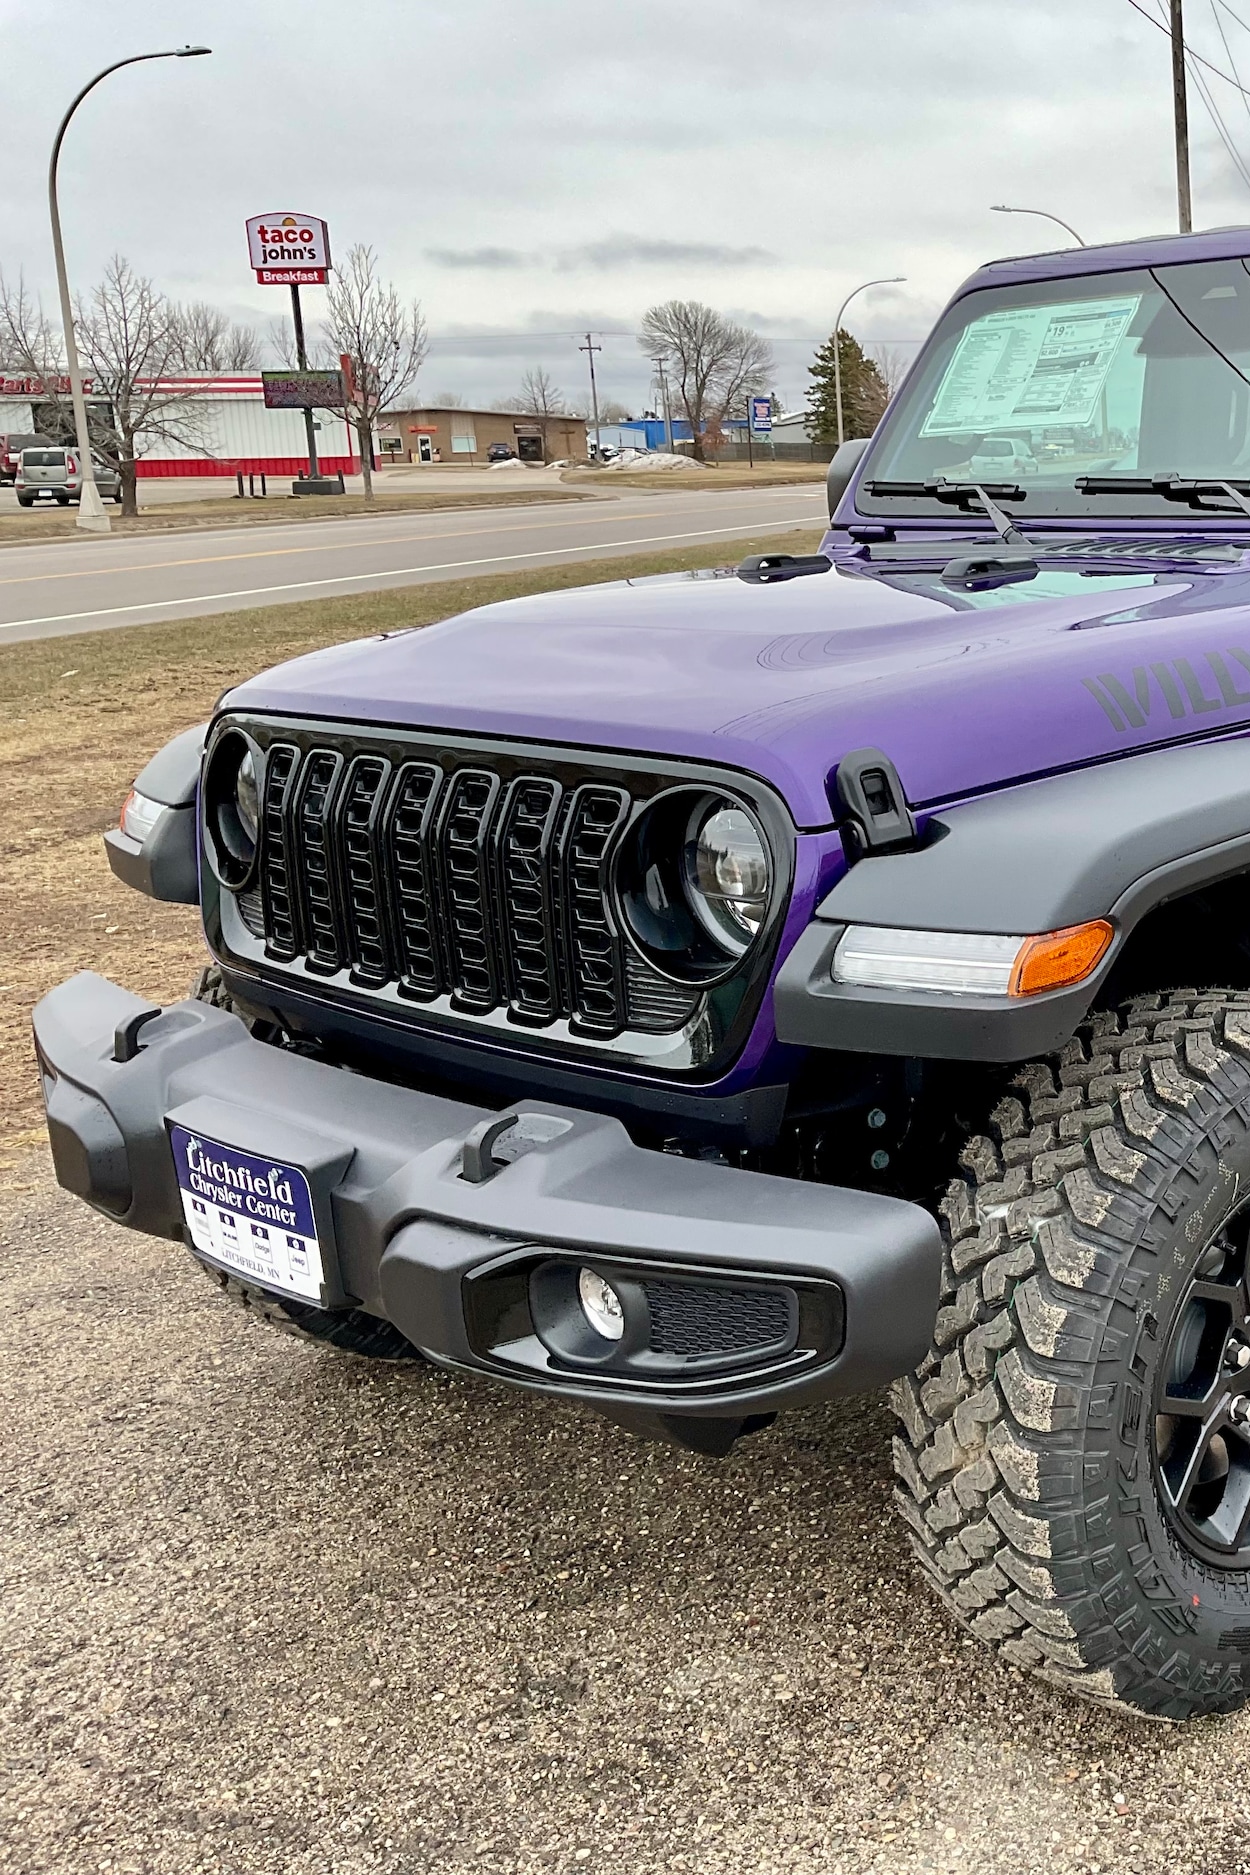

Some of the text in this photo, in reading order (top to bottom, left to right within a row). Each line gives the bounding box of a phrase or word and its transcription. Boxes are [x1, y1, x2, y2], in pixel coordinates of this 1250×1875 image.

[258, 225, 314, 244] taco
[262, 245, 317, 264] john's
[263, 270, 319, 282] Breakfast
[1053, 326, 1065, 337] 19
[186, 1146, 294, 1205] Litchfield
[190, 1172, 296, 1226] Chrysler Center
